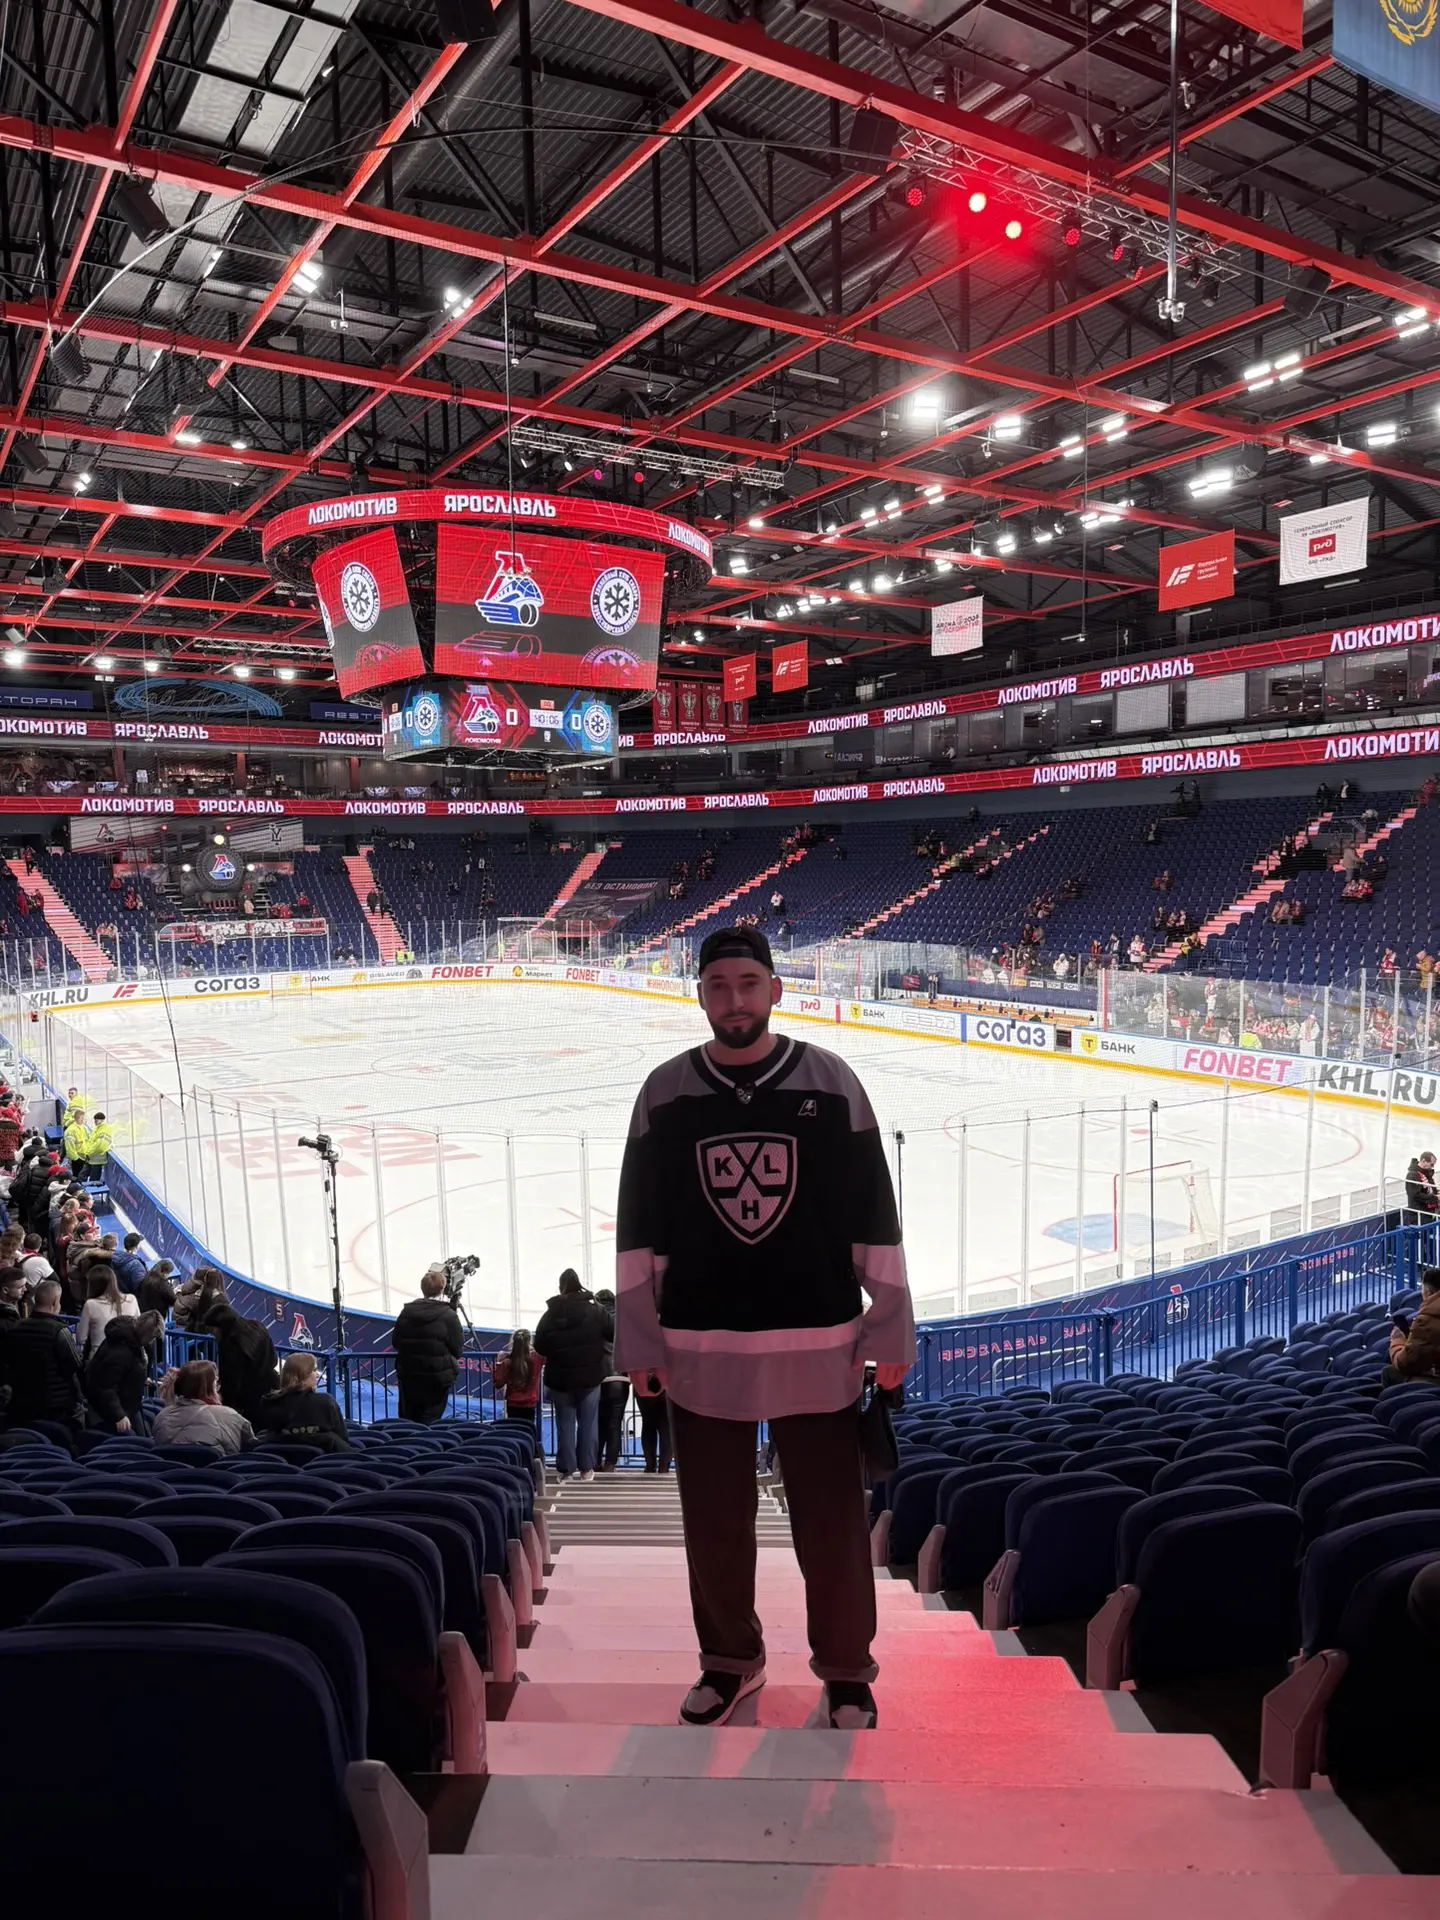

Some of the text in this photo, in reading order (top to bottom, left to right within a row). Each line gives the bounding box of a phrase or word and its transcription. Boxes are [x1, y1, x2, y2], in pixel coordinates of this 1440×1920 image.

[308, 497, 398, 525] ЛОКОМОТИВ
[444, 494, 557, 518] ЯРОСЛАВЛЬ
[997, 658, 1195, 705] ЛОКОМОТИВ ЯРОСЛАВЛЬ
[0, 696, 77, 706] ТОРАН
[506, 708, 518, 726] 0
[572, 713, 582, 730] 0
[807, 700, 947, 734] ЛОКОМОТИВ ЯРОСЛАВЛЬ
[115, 723, 209, 740] ЯРОСЛАВЛЬ
[1032, 730, 1440, 784] ЛОКОМОТИВ ЯРОСЛАВЛЬ ЛОКОМОТИ
[813, 777, 945, 803] ЛОКОМОТИВ ЯРОСЛАВЛЬ
[81, 798, 285, 814] ЛОКОМОТИВ ЯРОСЛАВЛЬ
[344, 801, 525, 815] ЛОКОМОТИВ ЯРОСЛАВЛЬ
[615, 793, 769, 812] ЛОКОМОТИВ ЯРОСЛАВЛЬ
[431, 965, 494, 979] FONBET
[565, 967, 600, 983] FONBET
[29, 987, 89, 1009] KHL.RU
[863, 1008, 886, 1019] БАНК
[1101, 1041, 1136, 1054] БАНК
[1183, 1048, 1294, 1083] FONBET
[1317, 1063, 1438, 1105] KHL.RU
